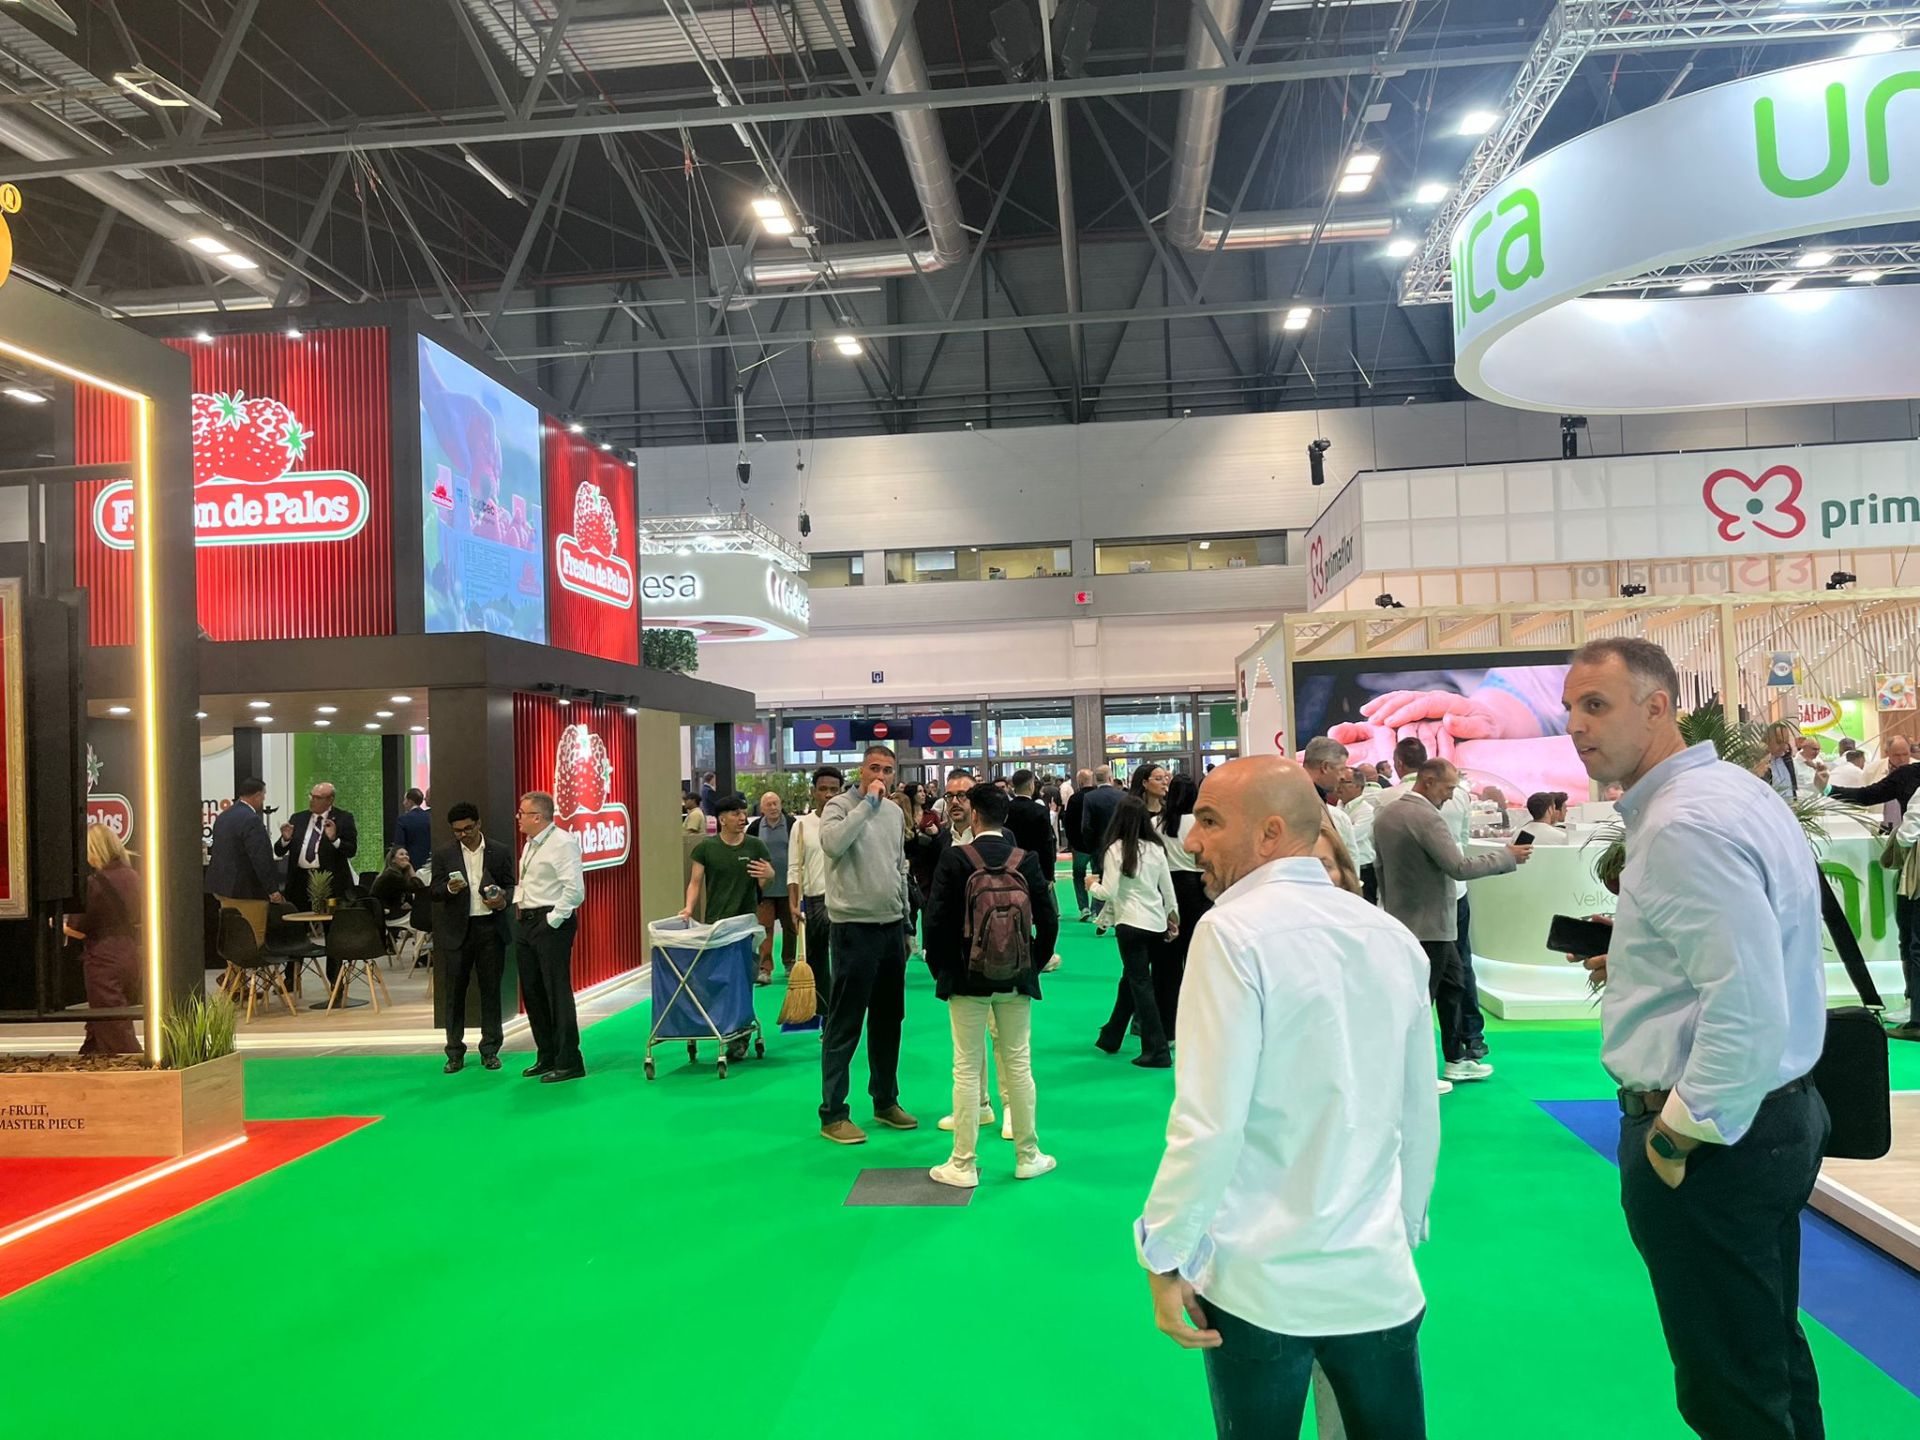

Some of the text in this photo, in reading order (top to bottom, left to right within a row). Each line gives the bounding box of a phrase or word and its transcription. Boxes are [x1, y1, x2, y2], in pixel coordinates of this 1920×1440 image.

[224, 493, 263, 528] de
[264, 490, 350, 527] Palos
[1821, 493, 1920, 538] prim
[562, 548, 630, 598] Fresón de Palos
[1325, 535, 1353, 587] primaflor
[583, 822, 598, 854] de
[597, 820, 626, 852] Palos
[9, 1104, 49, 1117] FRUIT,
[48, 1118, 86, 1130] PIECE
